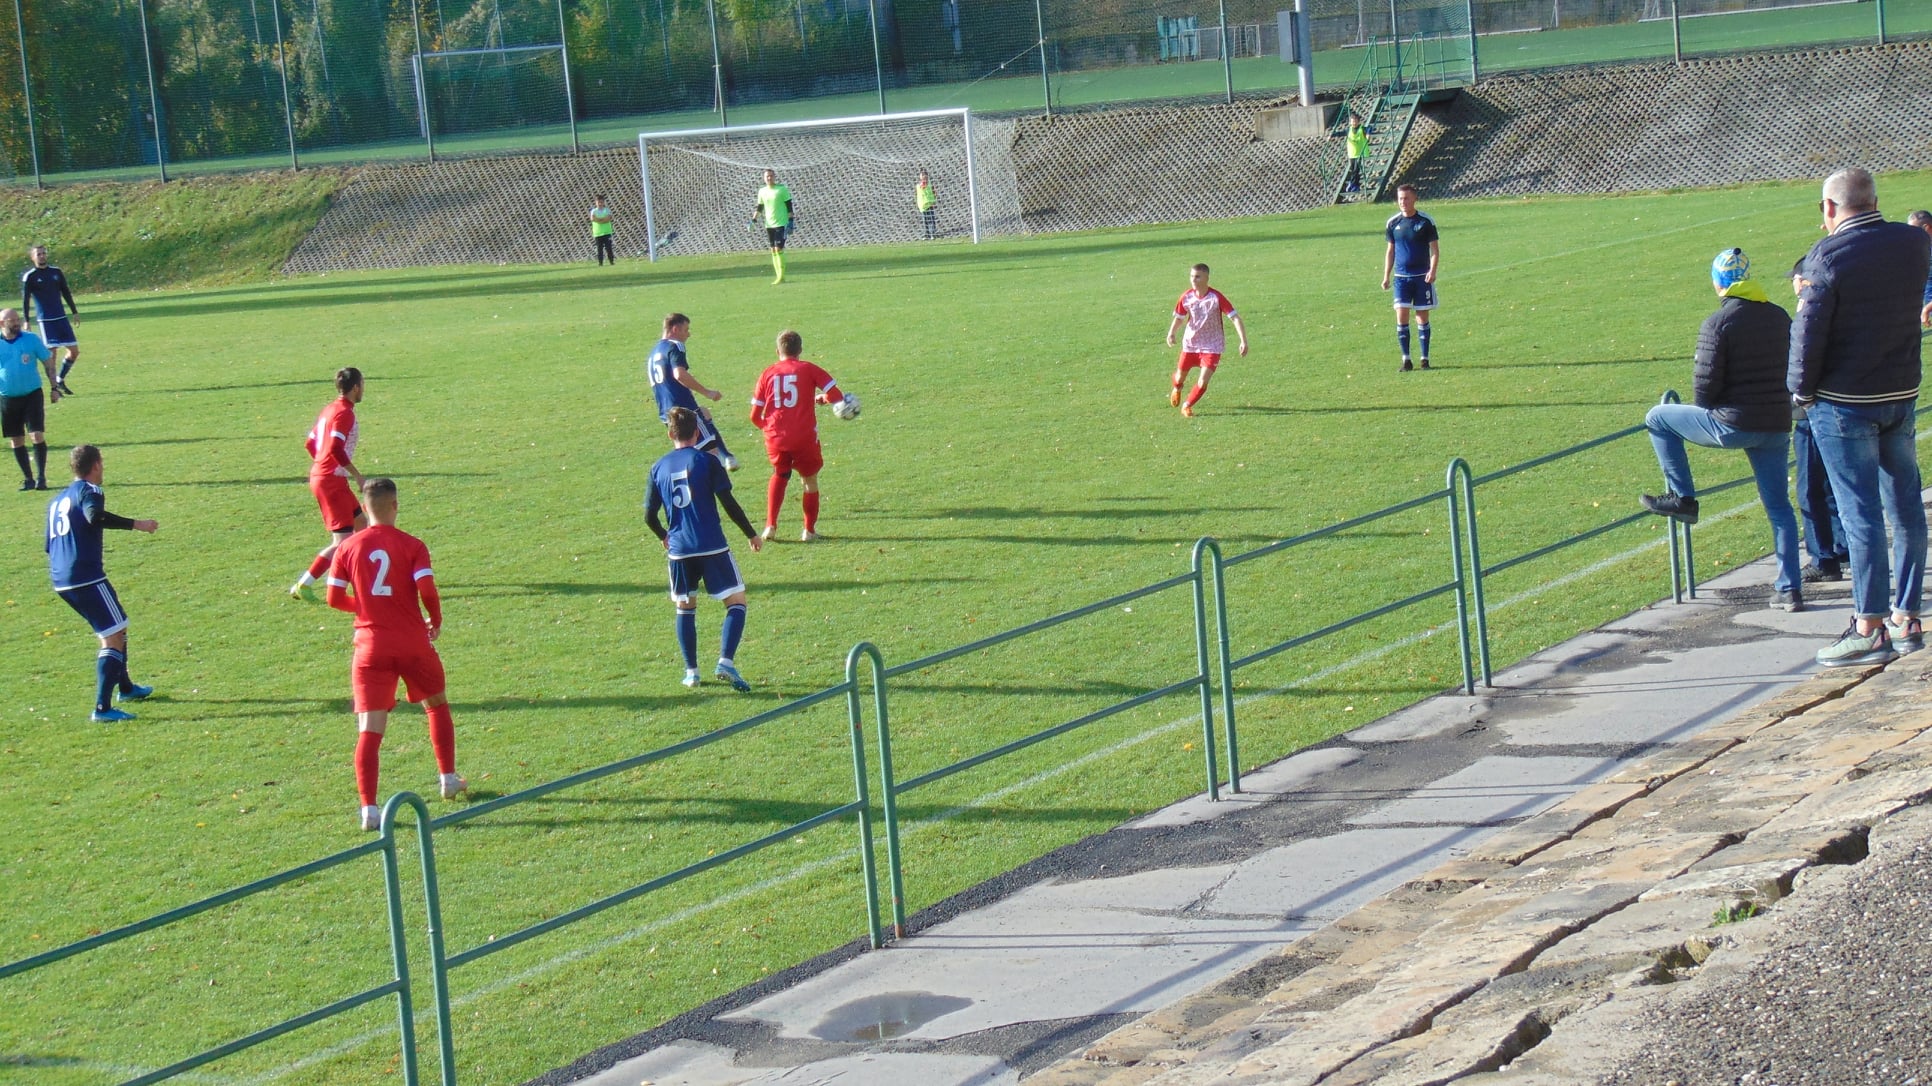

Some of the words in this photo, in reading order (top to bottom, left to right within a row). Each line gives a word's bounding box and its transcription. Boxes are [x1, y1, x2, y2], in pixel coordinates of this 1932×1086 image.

[647, 352, 664, 388] 15
[772, 374, 799, 409] 15
[670, 470, 693, 509] 5
[49, 496, 71, 539] 13
[369, 549, 393, 596] 2
